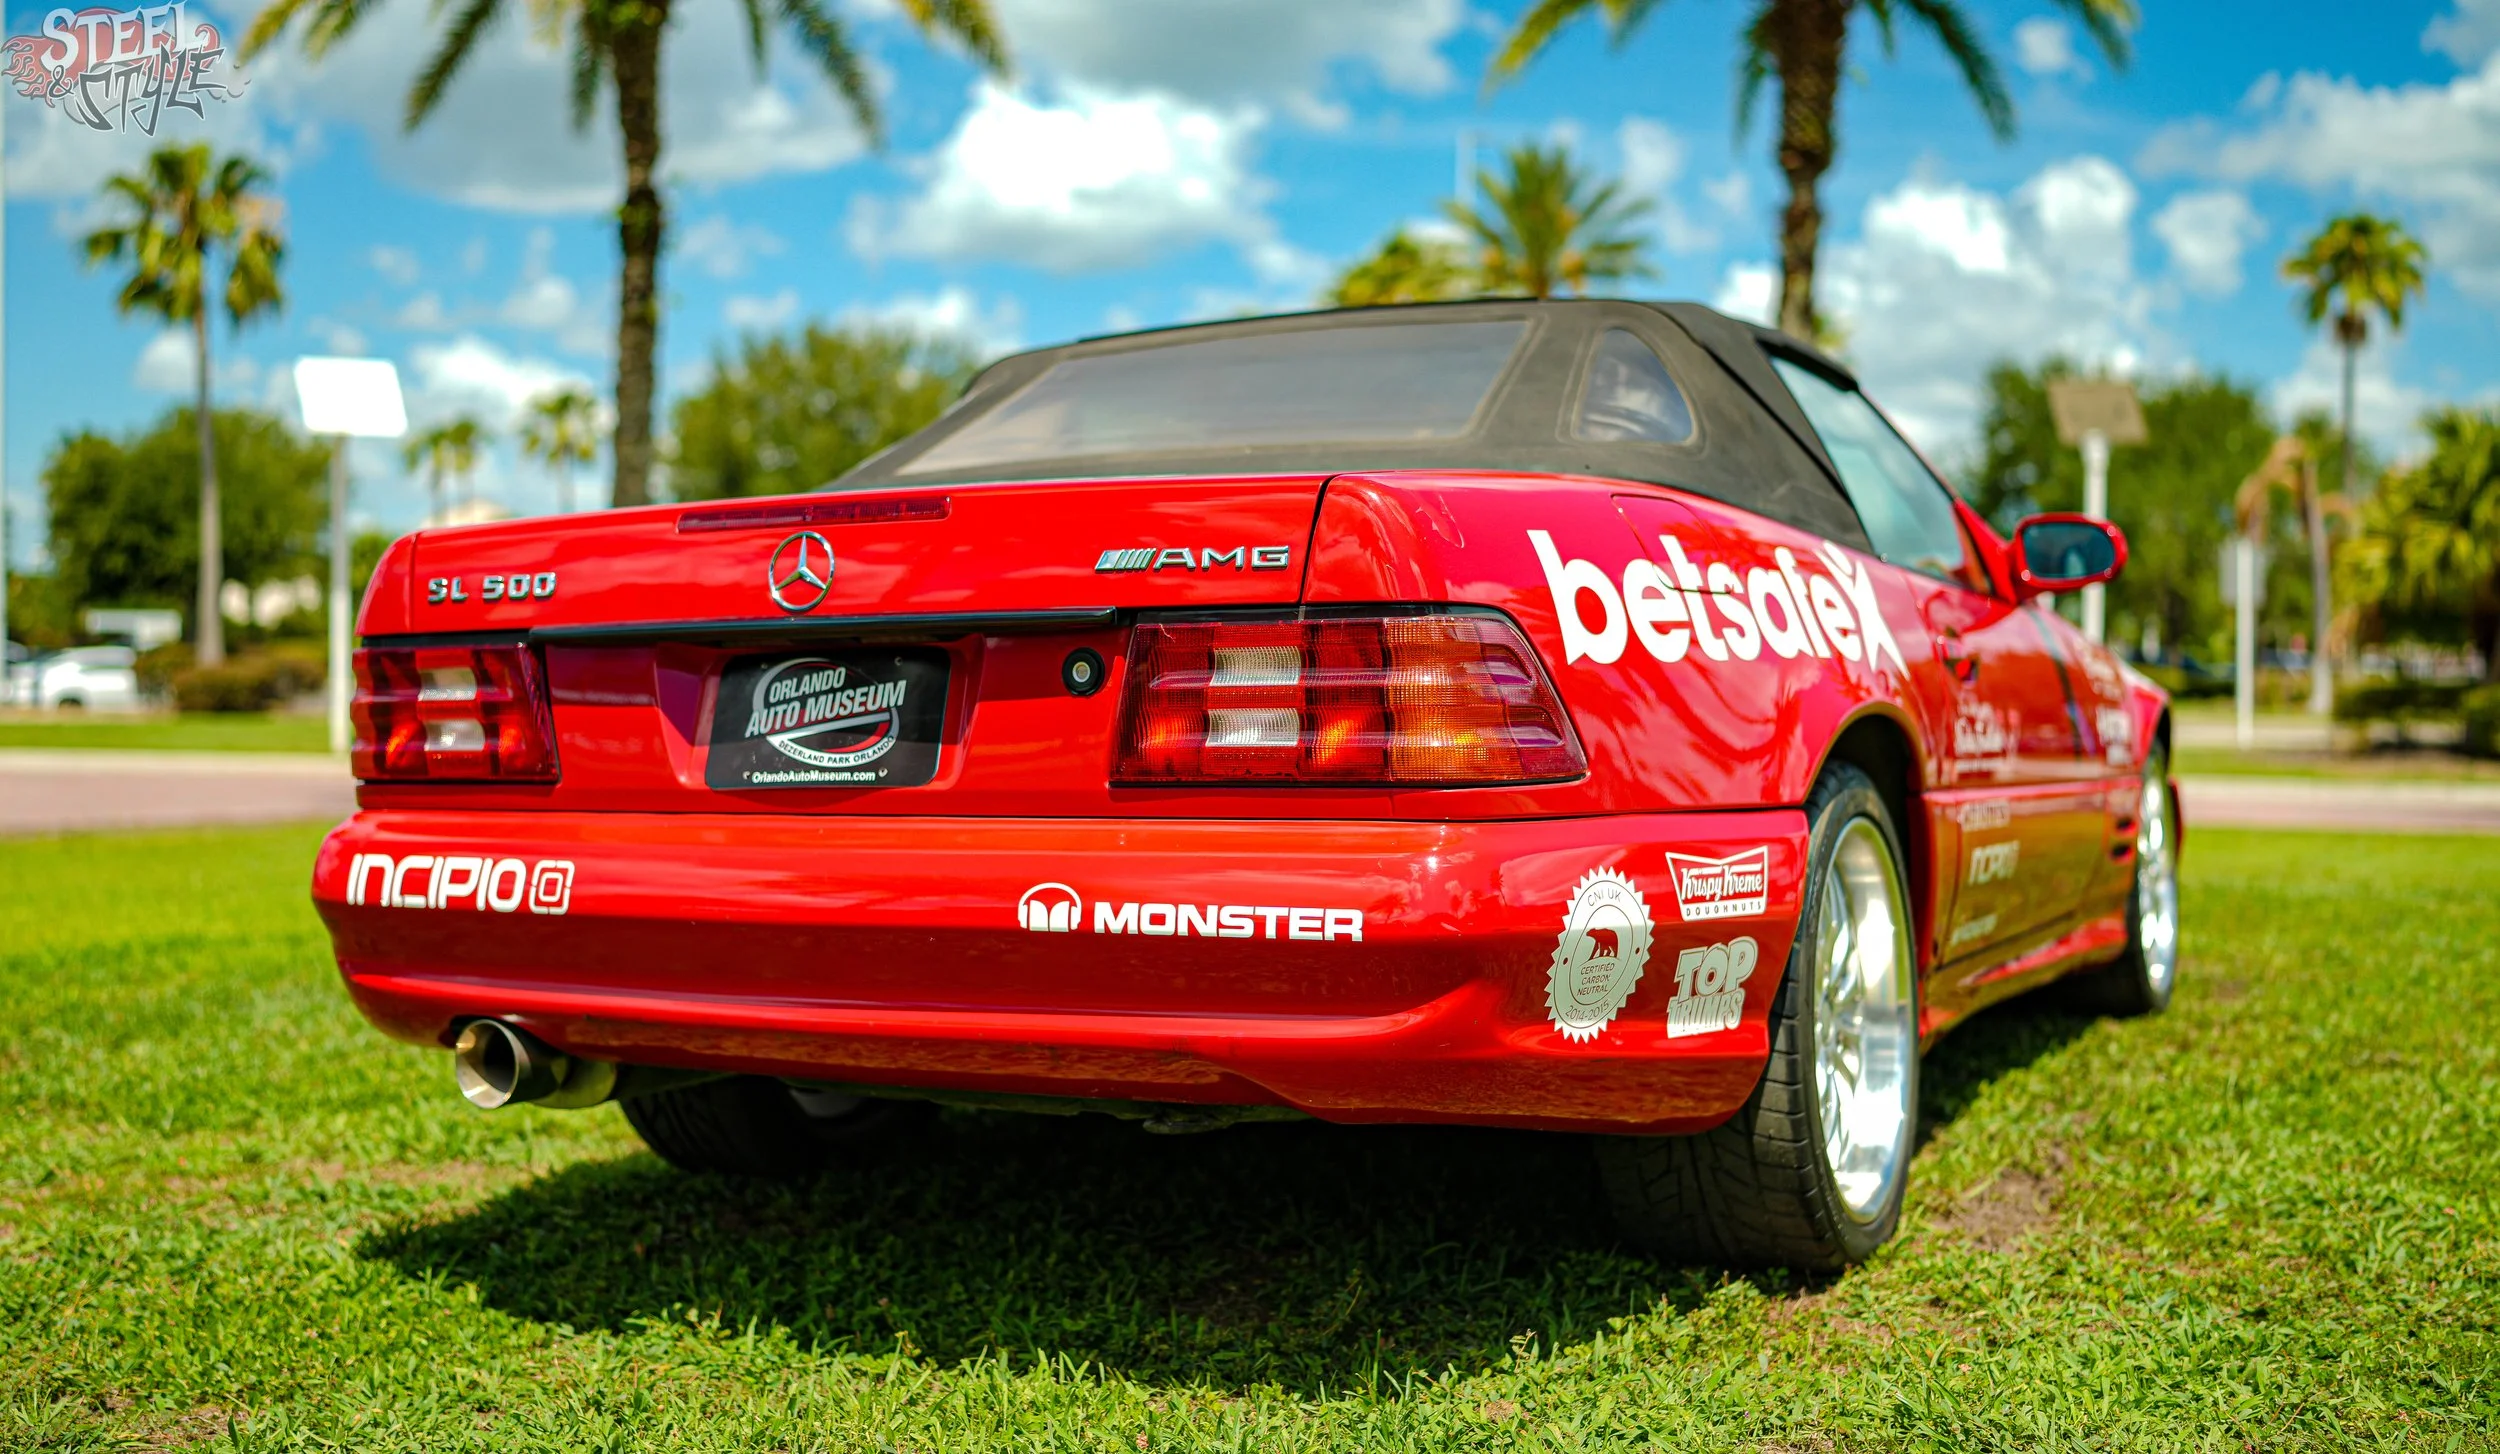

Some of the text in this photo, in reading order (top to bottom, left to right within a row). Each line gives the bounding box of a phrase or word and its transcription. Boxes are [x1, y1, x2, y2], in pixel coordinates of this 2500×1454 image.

[1153, 546, 1289, 569] AMG
[427, 572, 557, 602] SL 500
[769, 667, 847, 703] ORLANDO
[745, 680, 907, 739] AUTO MUSEUM
[778, 735, 896, 765] DEZERLAND PARK ORLANDO
[752, 768, 876, 784] OrlandoAutoMuseum.com
[346, 853, 527, 913] INCIPIO
[1587, 887, 1622, 907] CNI UK
[1681, 863, 1763, 901] Krispy Kreme
[1094, 901, 1363, 942] MONSTER
[1686, 901, 1762, 917] DOUGHNUTS
[1581, 963, 1615, 975] CERTIFIED
[1582, 974, 1611, 986] CARBON
[1674, 936, 1758, 1003] TOP
[1577, 984, 1608, 996] NEUTRAL
[1565, 999, 1610, 1022] 2014-2015
[1667, 988, 1745, 1038] TRUMPS
